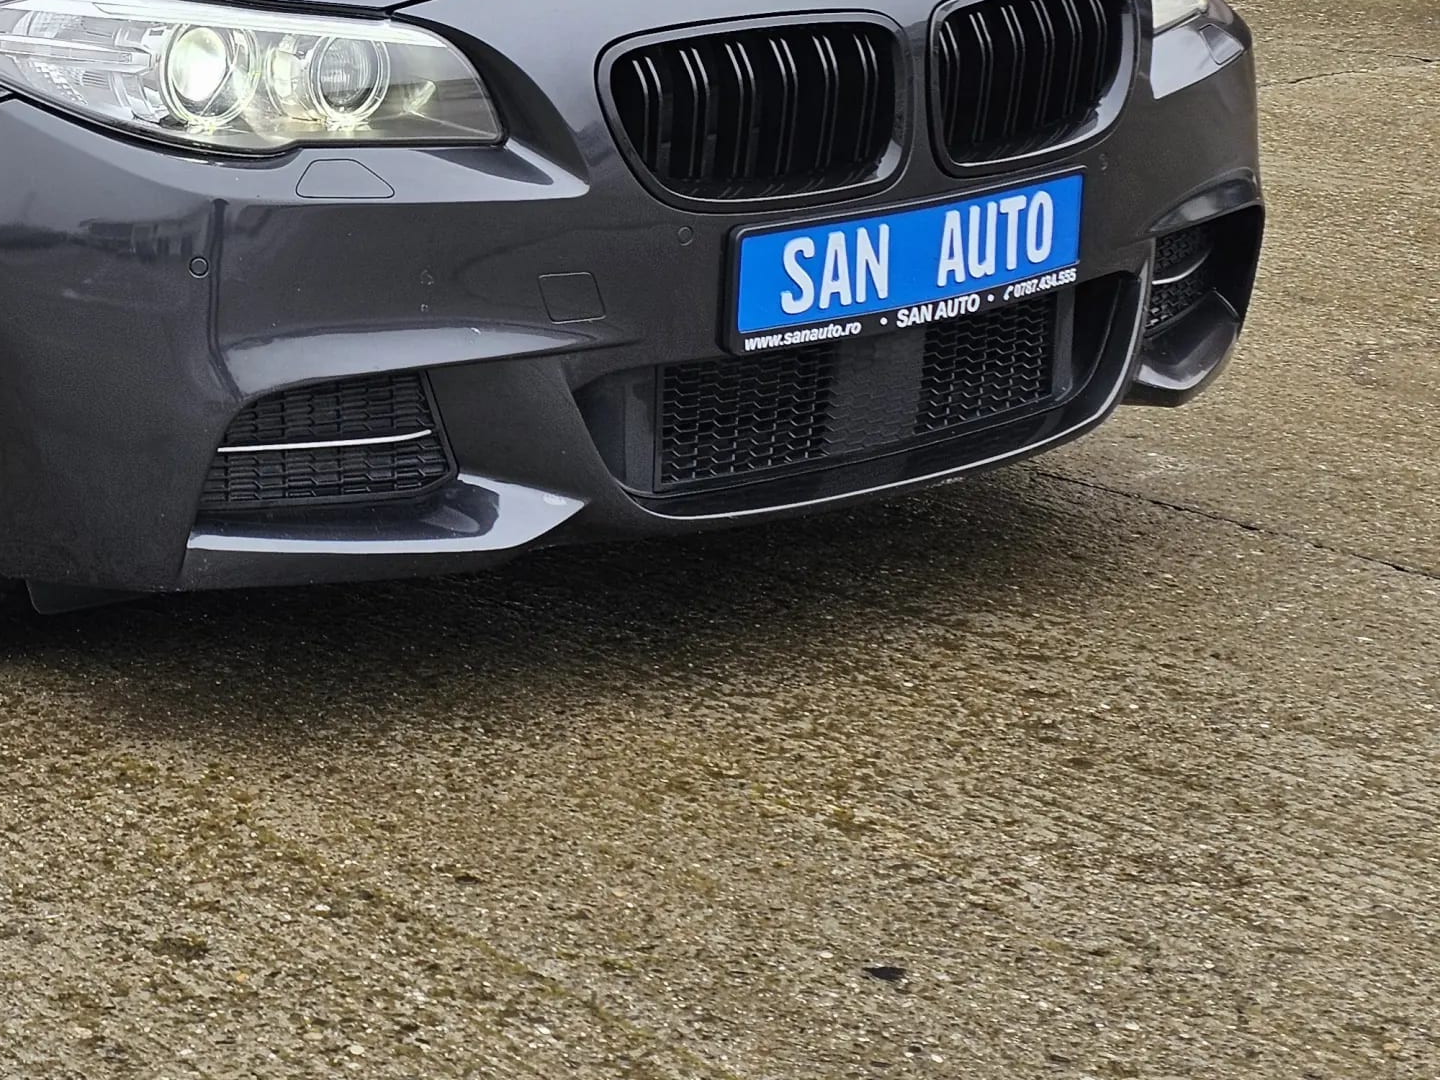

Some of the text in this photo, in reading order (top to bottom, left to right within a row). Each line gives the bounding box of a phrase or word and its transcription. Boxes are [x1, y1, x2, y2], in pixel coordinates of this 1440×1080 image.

[780, 190, 1054, 315] SAN AUTO
[744, 322, 862, 352] www.sanauto.ro
[896, 304, 933, 328] SAN
[934, 293, 980, 320] AUTO
